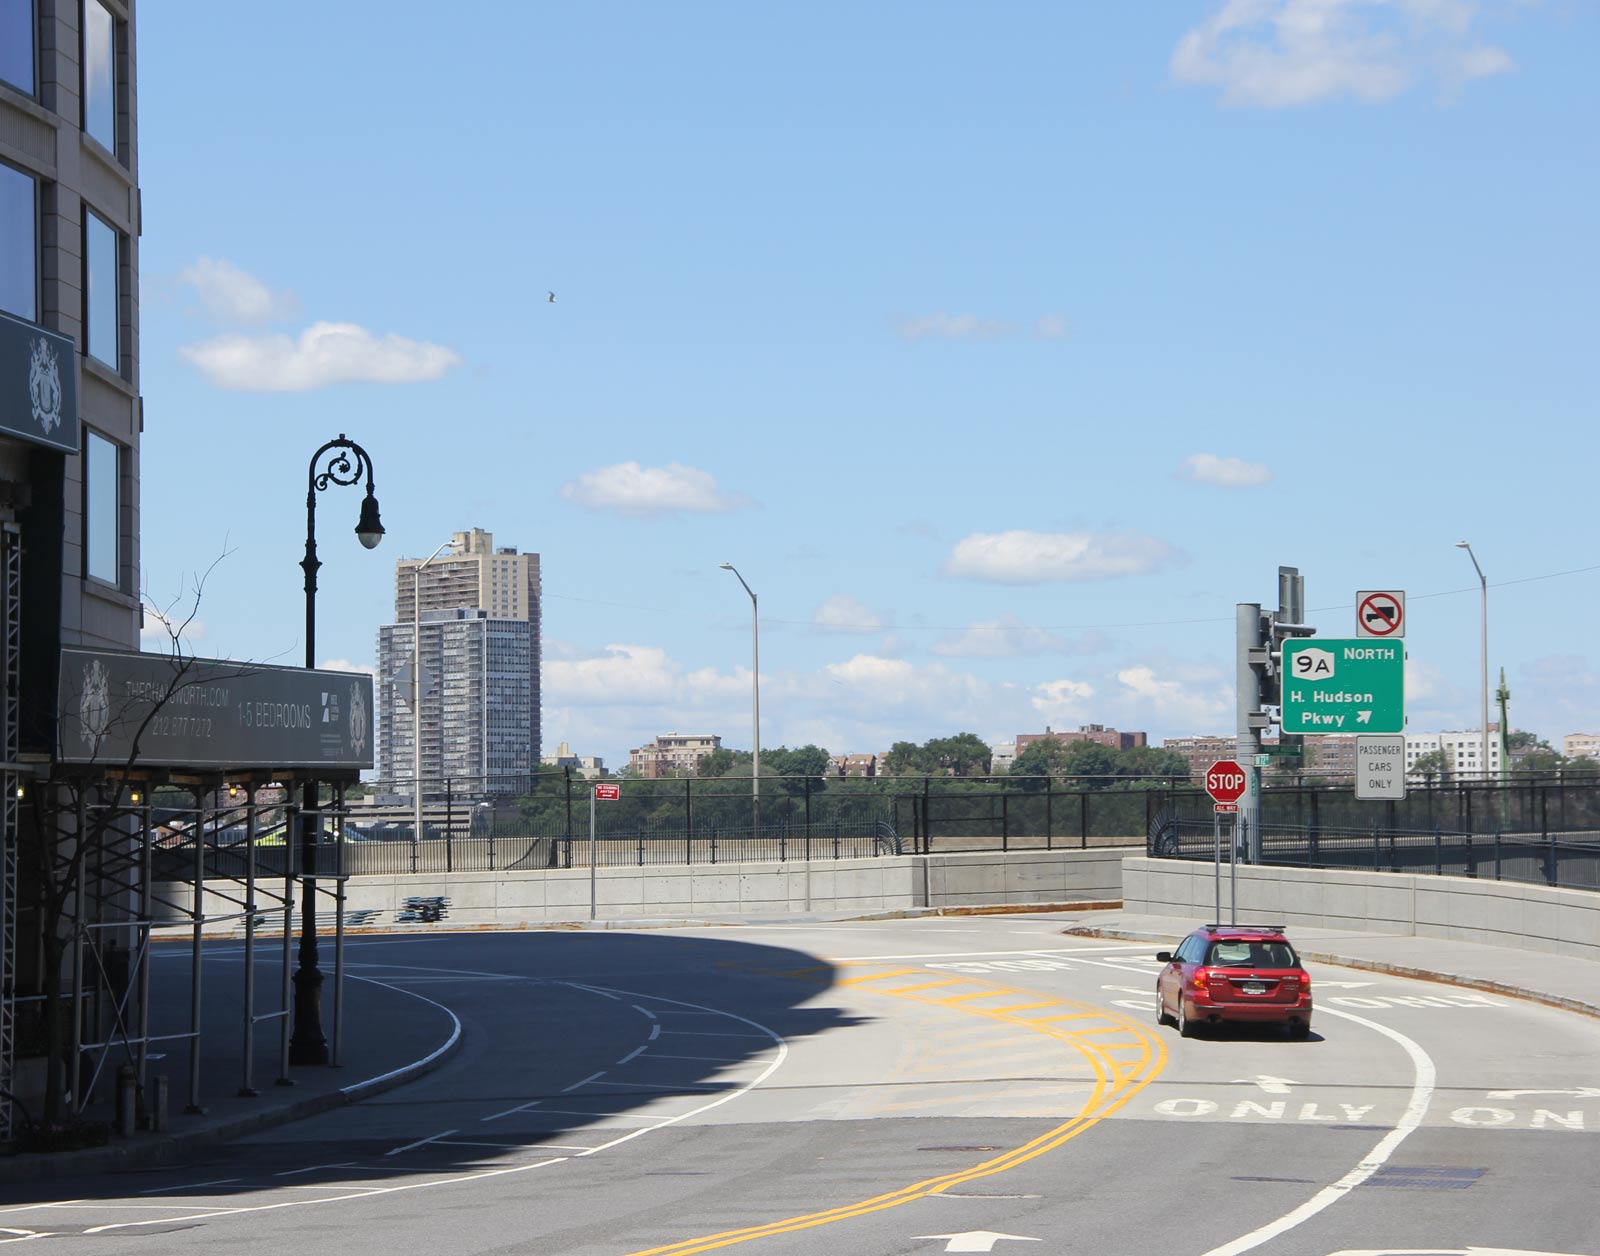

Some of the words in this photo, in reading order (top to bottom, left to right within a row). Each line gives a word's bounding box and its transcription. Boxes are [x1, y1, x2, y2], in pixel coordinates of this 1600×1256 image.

[1344, 648, 1395, 660] NORTH
[1296, 655, 1330, 673] 9A
[1290, 690, 1305, 703] H.
[1313, 690, 1374, 703] Hudson
[237, 701, 253, 727] 1-5
[255, 702, 311, 729] BEDROOMS
[1301, 711, 1345, 728] Pkwy
[1359, 745, 1400, 755] PASSENGER
[1368, 762, 1392, 772] CARS
[1208, 774, 1244, 790] STOP
[1369, 779, 1392, 789] ONLY
[1327, 995, 1511, 1009] ONLY
[1152, 1098, 1376, 1122] ONLY
